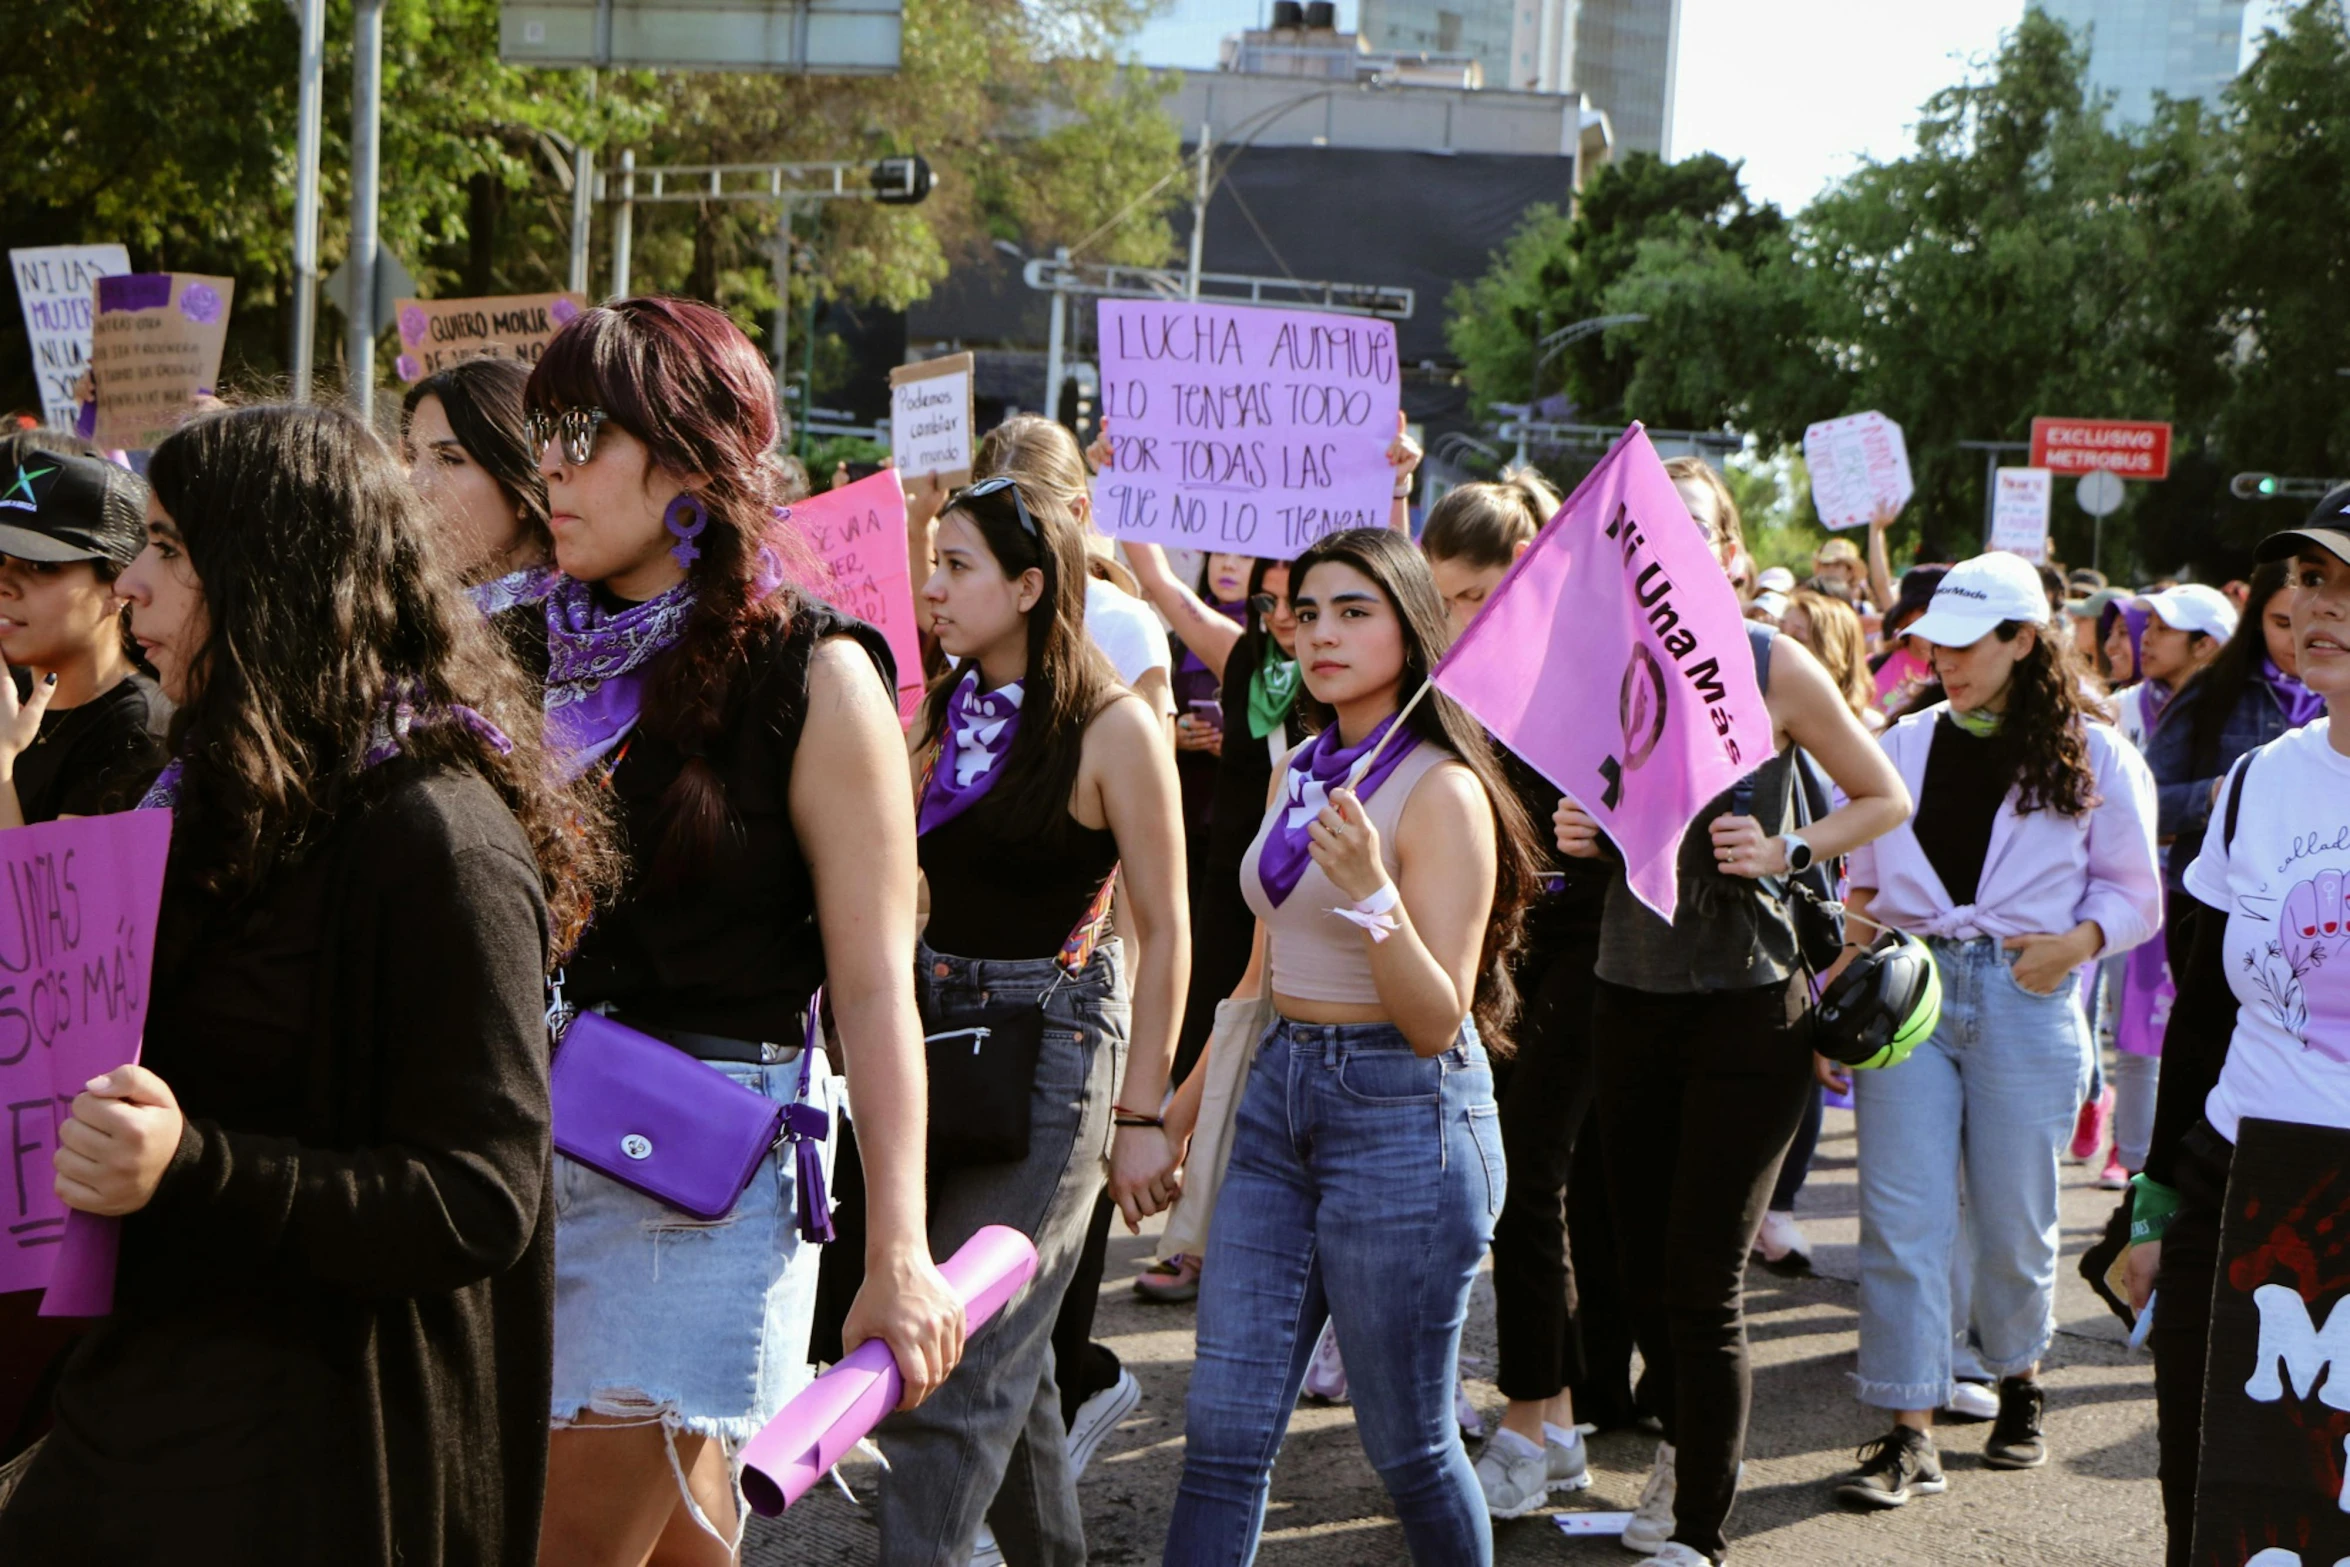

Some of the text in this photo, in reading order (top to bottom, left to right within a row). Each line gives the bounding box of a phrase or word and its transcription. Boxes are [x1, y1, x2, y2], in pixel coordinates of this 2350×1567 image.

[21, 260, 56, 293] NI
[30, 298, 93, 332] MUJER
[430, 306, 552, 343] QUIERO MORIR
[1118, 314, 1243, 366] LUCHA
[898, 386, 953, 412] Podemos
[1109, 379, 1147, 420] LO
[1284, 383, 1371, 427] TODO
[911, 411, 959, 439] cambiar
[2046, 426, 2156, 450] EXCLUSIVO
[920, 436, 959, 466] mundo
[1109, 435, 1336, 489] POR TODAS LAS
[2045, 449, 2153, 471] METROBUS
[1171, 494, 1206, 533] NO
[1221, 501, 1258, 543] LO
[1936, 586, 1987, 601] orMade
[1634, 561, 1697, 662] Una
[1684, 656, 1741, 766] Más
[83, 914, 141, 1025] MÁS
